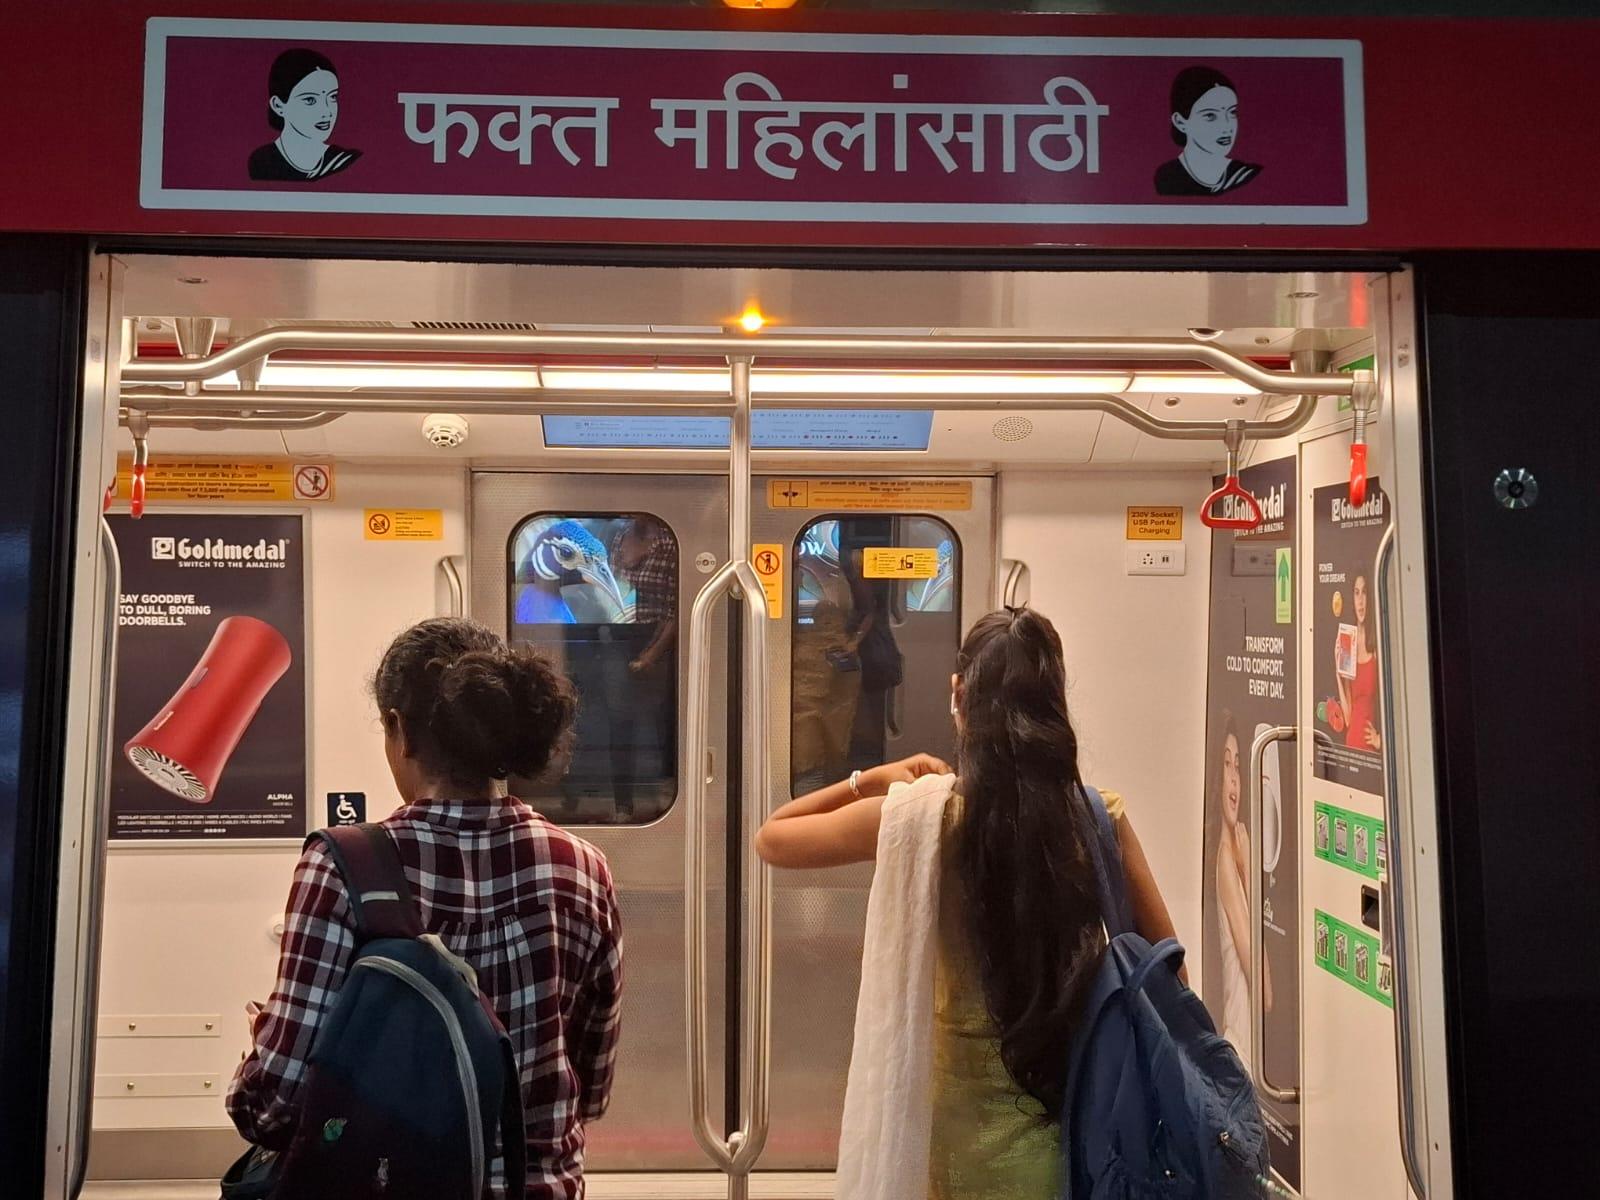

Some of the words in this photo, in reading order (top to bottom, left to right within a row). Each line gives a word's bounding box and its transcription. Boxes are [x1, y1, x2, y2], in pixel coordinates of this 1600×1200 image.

[398, 92, 620, 167] फक्त
[651, 71, 1110, 181] महिलांसाठी
[1138, 527, 1171, 535] Charging
[178, 538, 285, 560] Goldmedal
[246, 561, 286, 569] AMAZING
[120, 594, 139, 604] SAY
[141, 594, 195, 604] GOODBYE
[120, 605, 134, 615] TO
[136, 606, 167, 617] DULL,
[169, 605, 211, 615] BORING
[119, 616, 187, 626] DOORBELLS.
[1245, 636, 1284, 654] TRANSFORM
[1226, 655, 1242, 671] COLD
[1243, 657, 1251, 673] TO
[1252, 658, 1284, 677] COMFORT.
[1249, 679, 1269, 697] EVERY
[1270, 682, 1284, 699] DAY.
